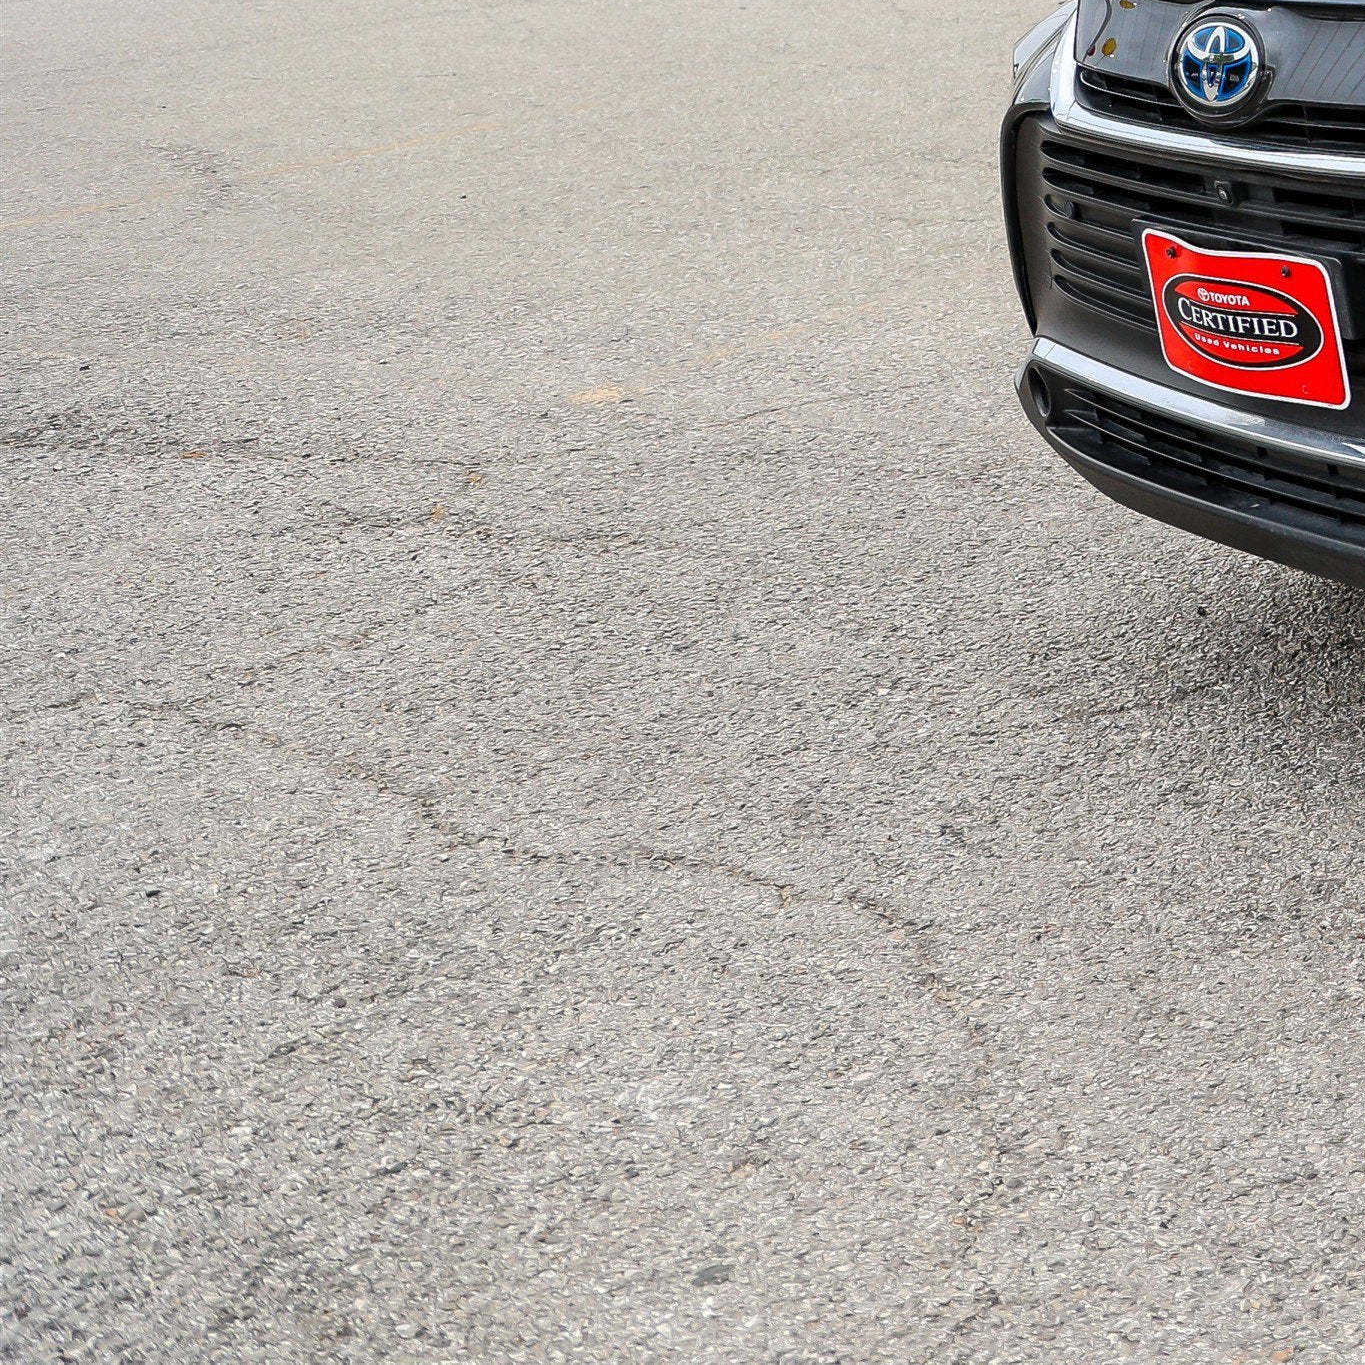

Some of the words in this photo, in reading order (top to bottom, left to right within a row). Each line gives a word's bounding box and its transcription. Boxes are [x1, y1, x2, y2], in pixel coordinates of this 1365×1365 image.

[1208, 291, 1251, 306] TOYOTA
[1177, 297, 1298, 338] CERTIFIED
[1194, 332, 1220, 346] Used
[1222, 340, 1280, 355] Vehicles
